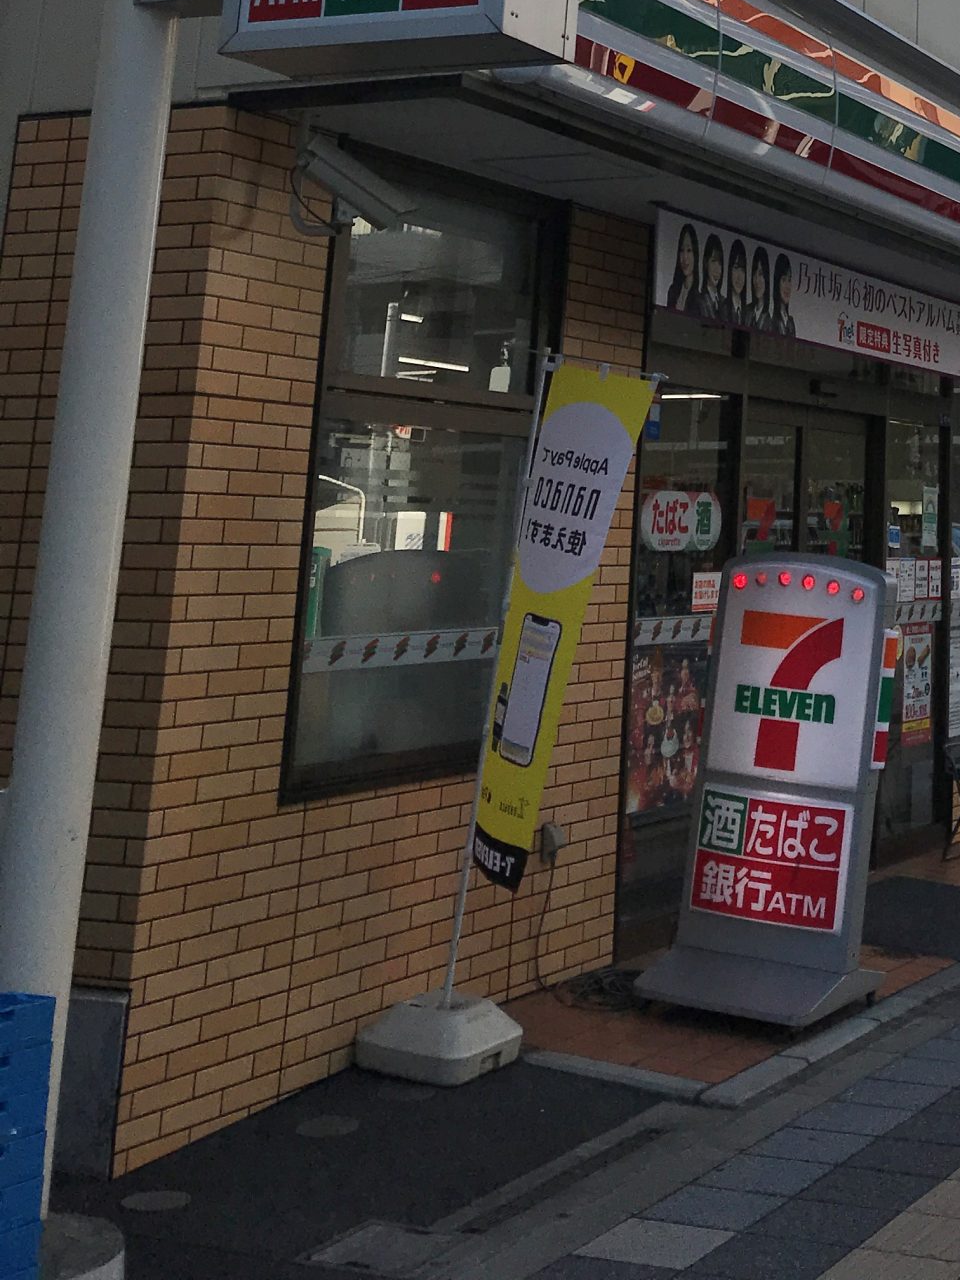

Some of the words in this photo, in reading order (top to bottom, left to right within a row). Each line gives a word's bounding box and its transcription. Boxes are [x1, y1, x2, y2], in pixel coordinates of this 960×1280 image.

[892, 331, 940, 363] 生写真付き
[651, 498, 689, 536] たばこ
[695, 500, 713, 536] 酒
[702, 795, 744, 852] 酒
[747, 807, 839, 862] たばこ
